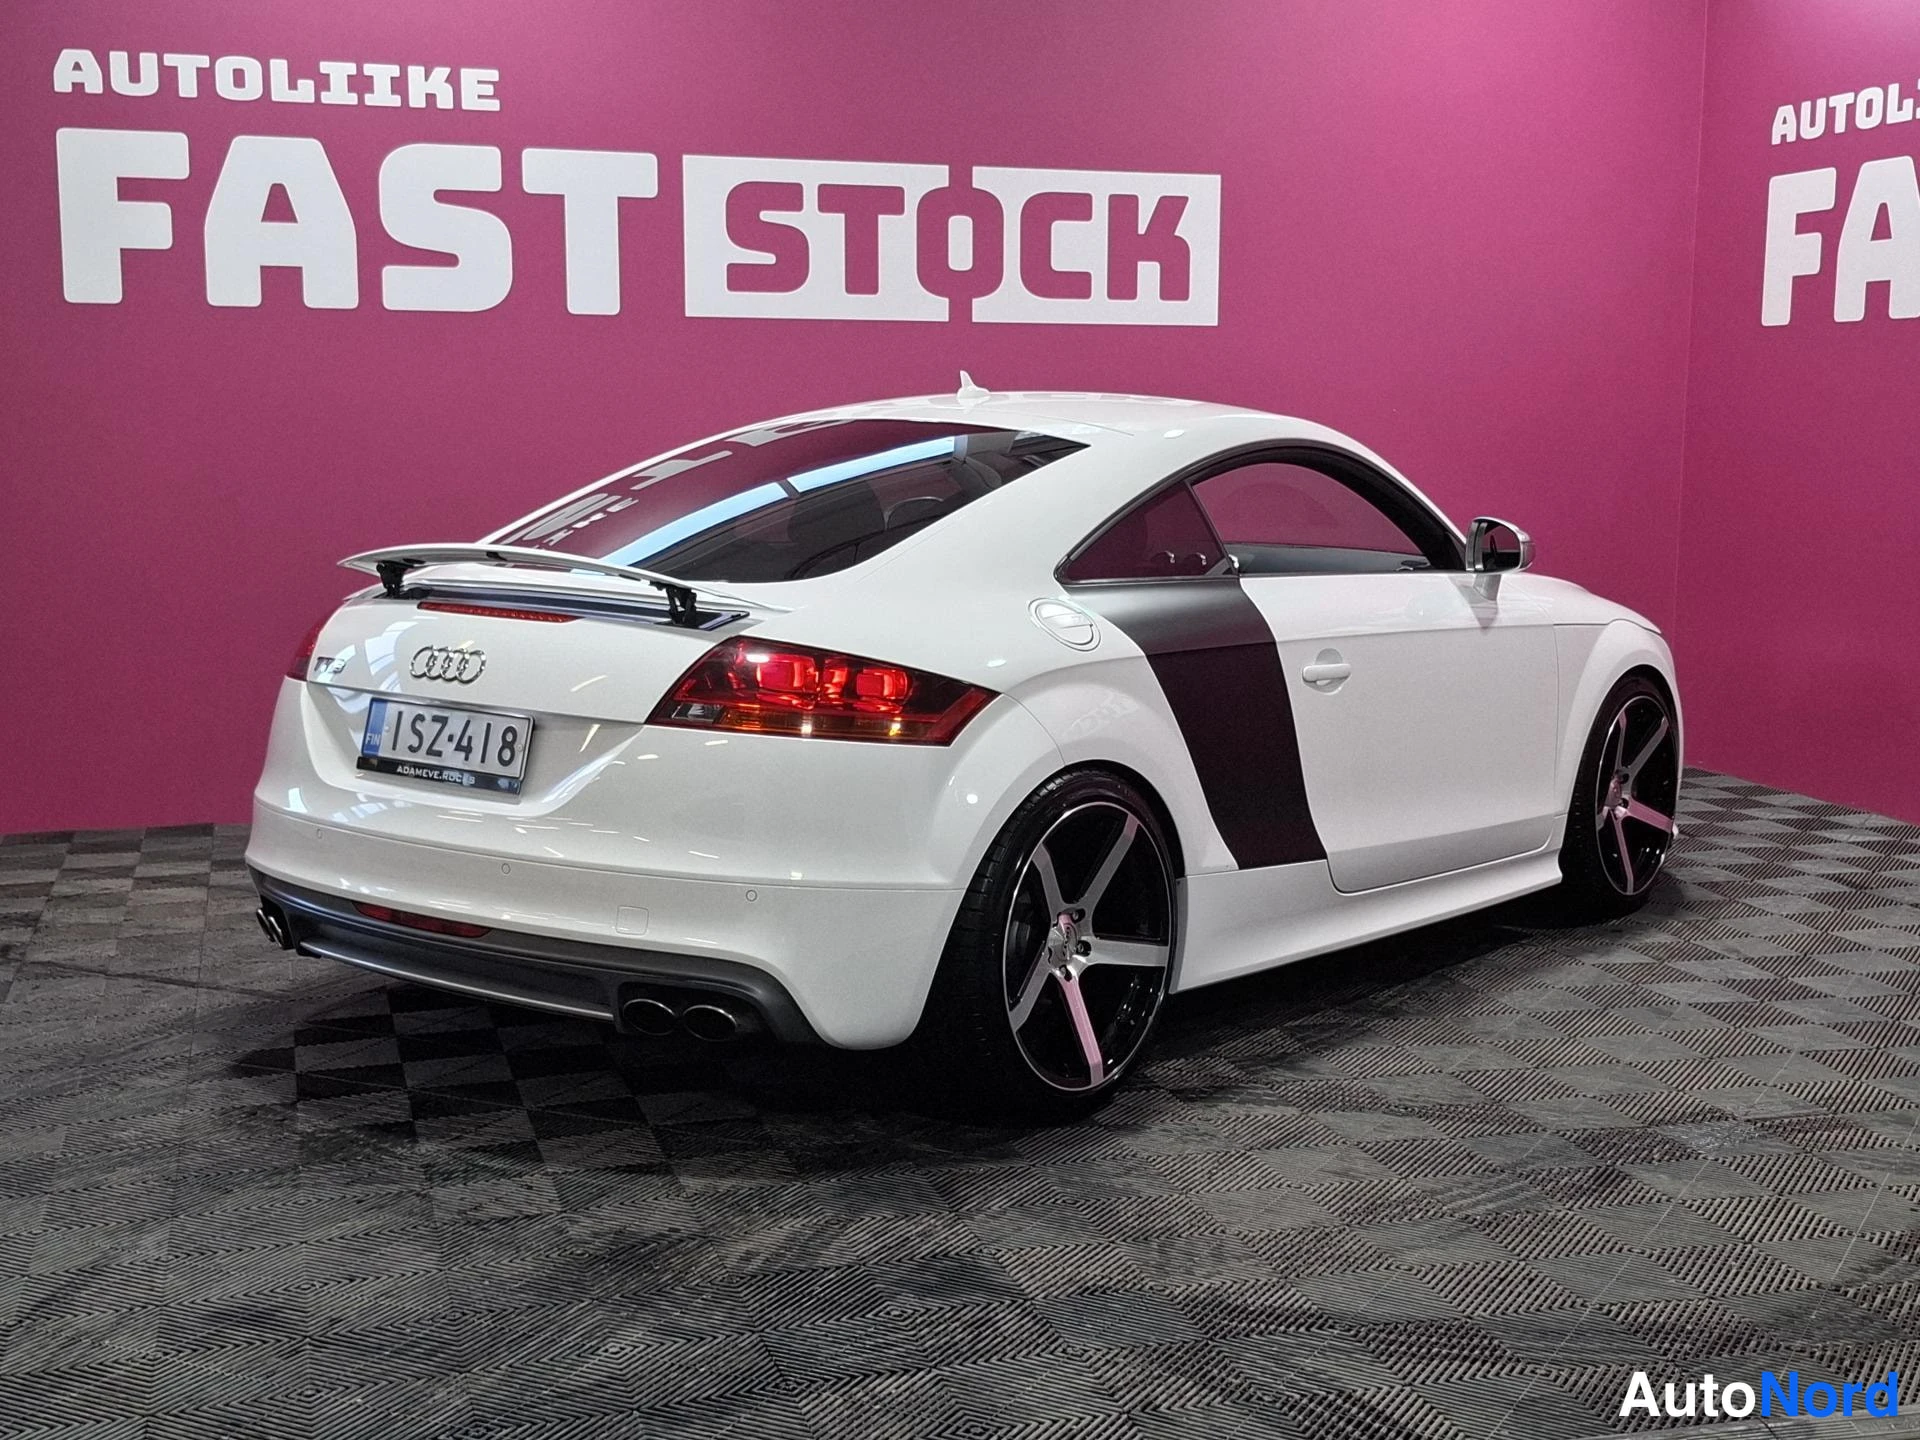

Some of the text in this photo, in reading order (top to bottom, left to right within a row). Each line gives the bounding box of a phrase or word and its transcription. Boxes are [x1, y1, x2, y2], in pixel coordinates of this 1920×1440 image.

[53, 48, 501, 112] AUTOLIIKE
[1771, 78, 1920, 145] AUTOL
[56, 128, 1191, 316] FAST STOCK
[1761, 155, 1920, 326] FA
[364, 732, 381, 746] FIN
[391, 711, 518, 766] ISZ-418
